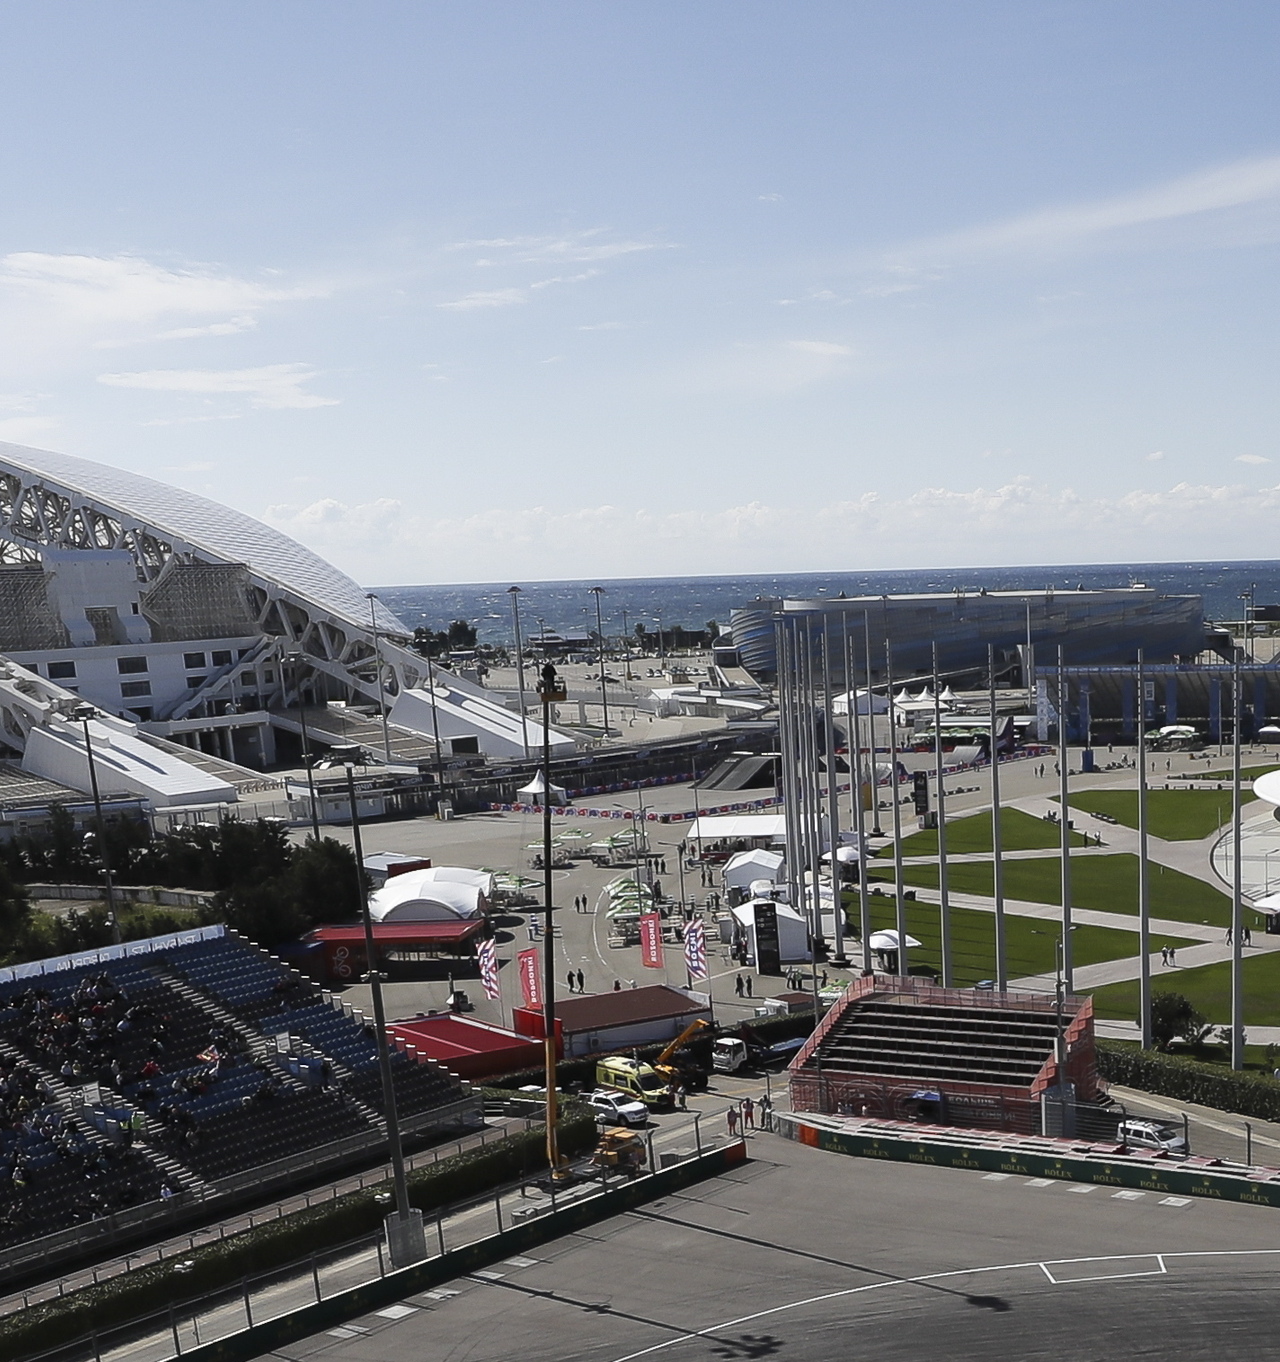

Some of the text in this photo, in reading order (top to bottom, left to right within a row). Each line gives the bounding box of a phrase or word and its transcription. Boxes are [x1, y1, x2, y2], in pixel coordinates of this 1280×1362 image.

[1045, 1168, 1072, 1178] ROLEX
[1093, 1174, 1122, 1184] ROLEX
[1140, 1180, 1169, 1191] ROLEX
[1192, 1186, 1221, 1197] ROLEX
[1240, 1193, 1269, 1204] ROLEX
